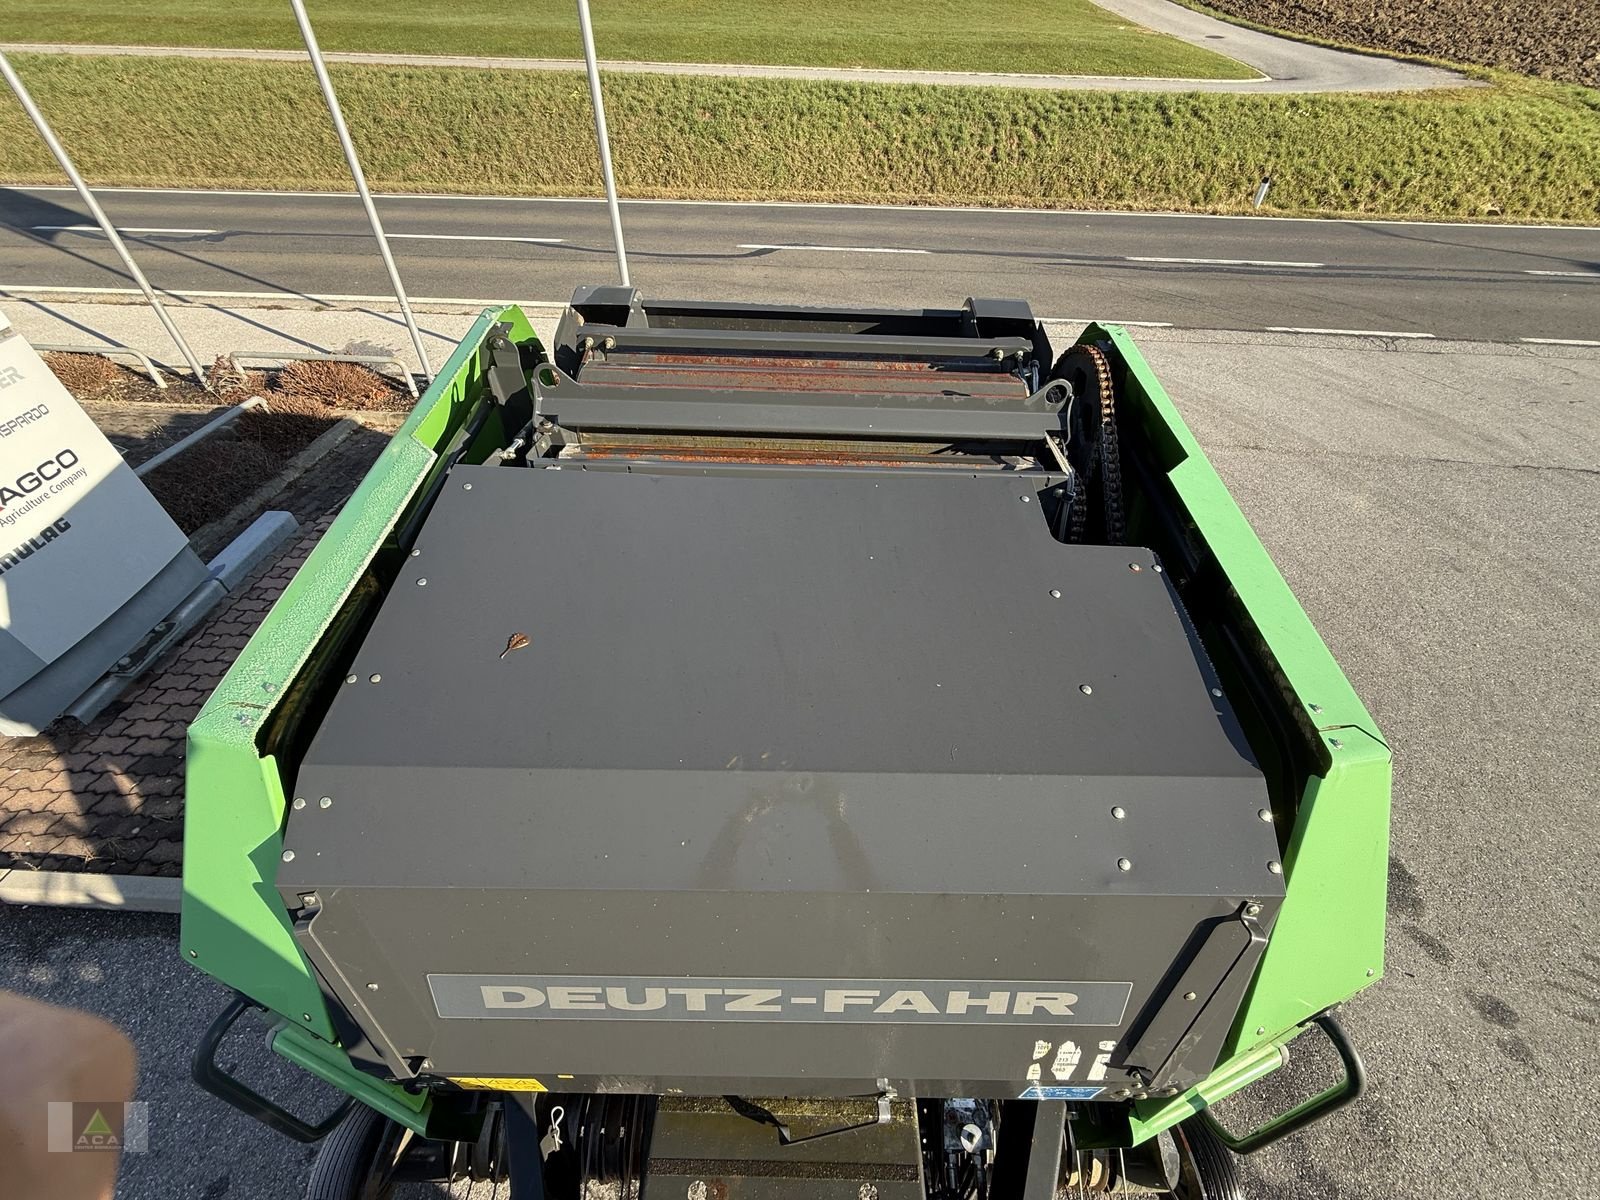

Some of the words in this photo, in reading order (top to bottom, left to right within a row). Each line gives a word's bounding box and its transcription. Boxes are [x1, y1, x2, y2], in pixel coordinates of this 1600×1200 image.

[0, 448, 79, 506] AGCO
[0, 491, 51, 528] Agriculture
[49, 467, 88, 494] Company
[480, 985, 1078, 1016] DEUTZ-FAHR
